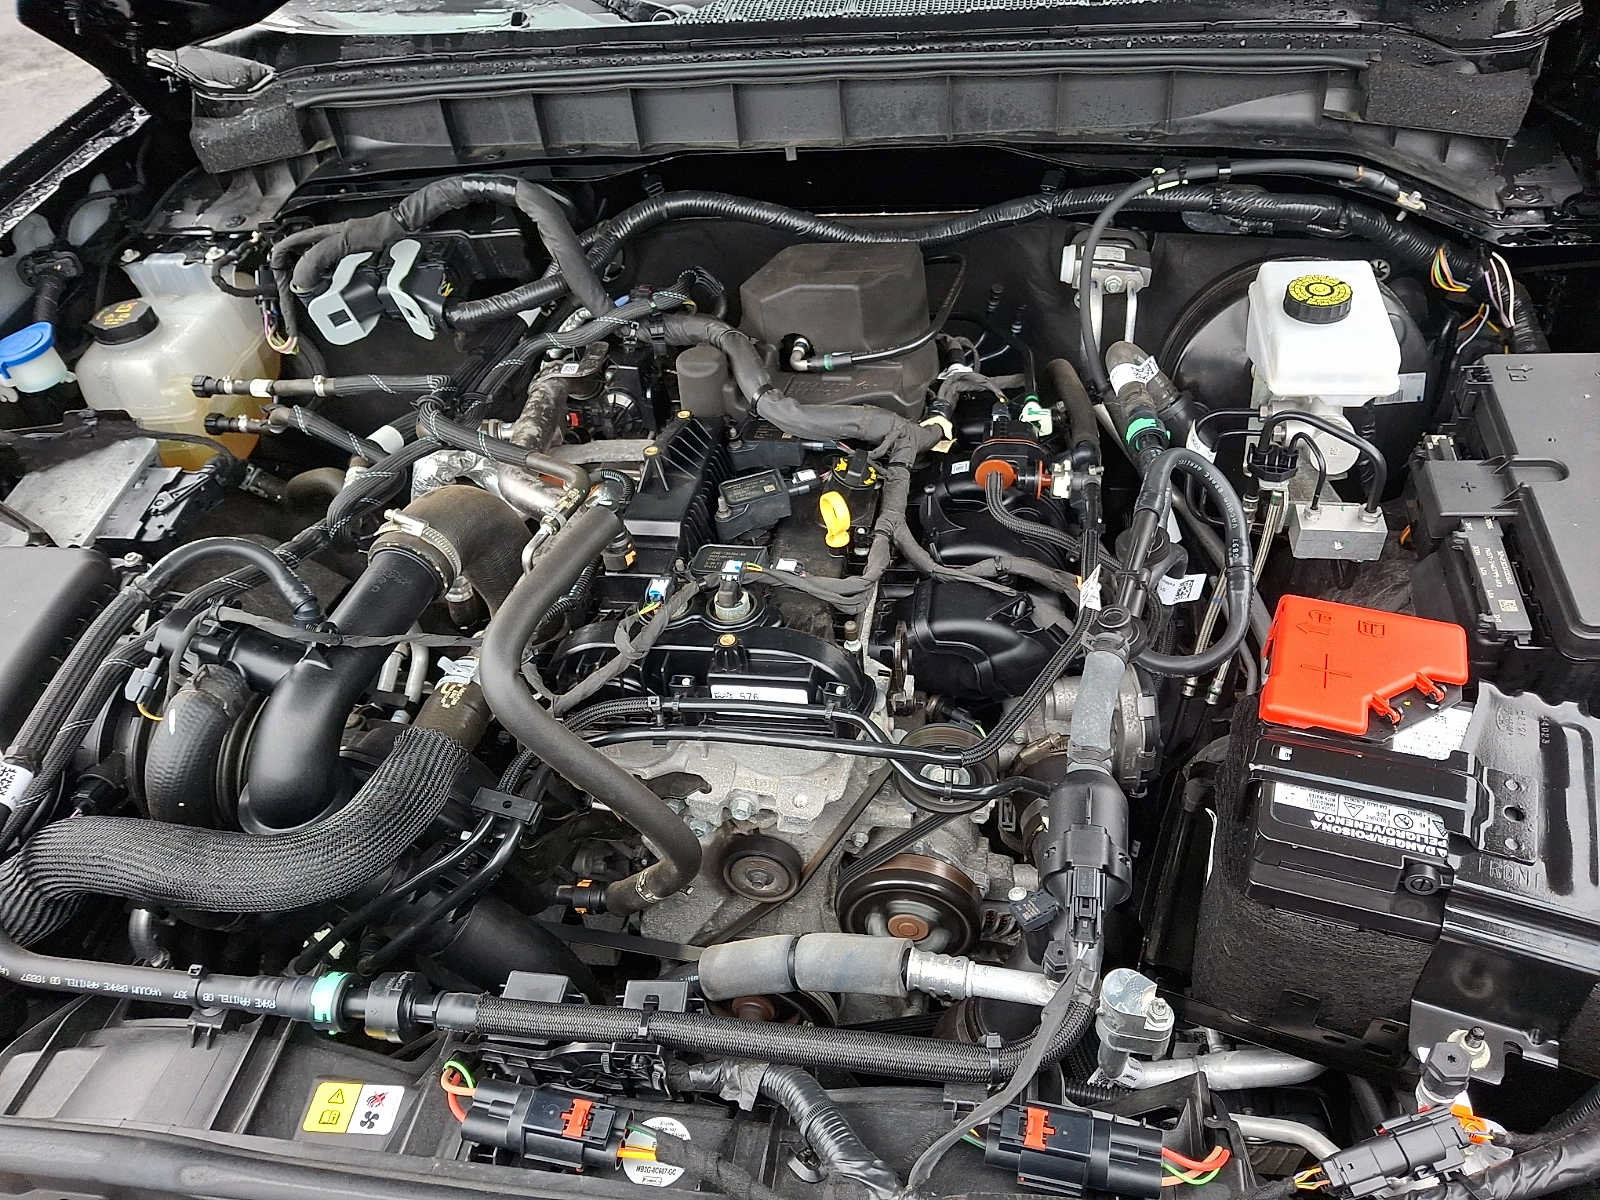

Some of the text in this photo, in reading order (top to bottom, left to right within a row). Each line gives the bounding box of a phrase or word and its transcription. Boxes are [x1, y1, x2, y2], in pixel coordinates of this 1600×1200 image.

[1203, 471, 1225, 494] BRAKE
[1320, 821, 1437, 856] DANGER/POISON
[1323, 813, 1448, 847] PELIGRO/VENENO
[103, 982, 129, 993] BRAKE
[131, 985, 162, 997] VACUUM
